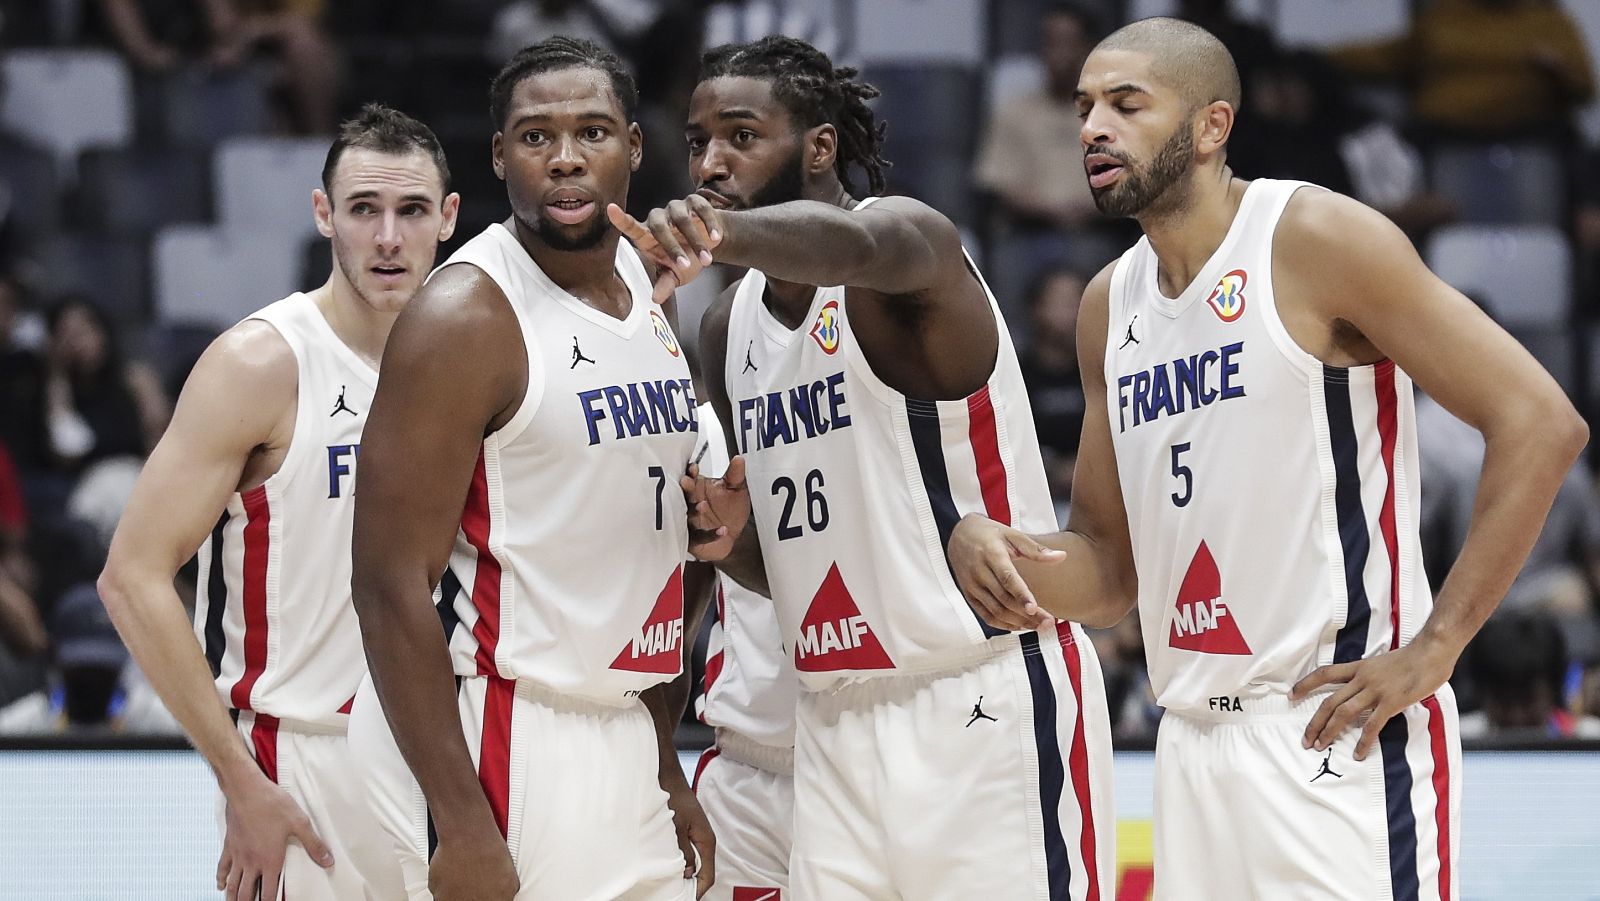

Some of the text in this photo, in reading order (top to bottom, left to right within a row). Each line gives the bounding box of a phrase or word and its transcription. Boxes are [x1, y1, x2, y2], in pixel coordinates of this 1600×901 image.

[576, 378, 698, 446] FRANCE
[738, 371, 852, 454] FRANCE
[1118, 341, 1247, 434] FRANCE
[648, 466, 666, 530] 7
[771, 468, 829, 541] 26
[1171, 441, 1193, 508] 5
[631, 617, 683, 658] MAIF
[798, 615, 868, 659] MAIF
[1209, 696, 1244, 712] FRA
